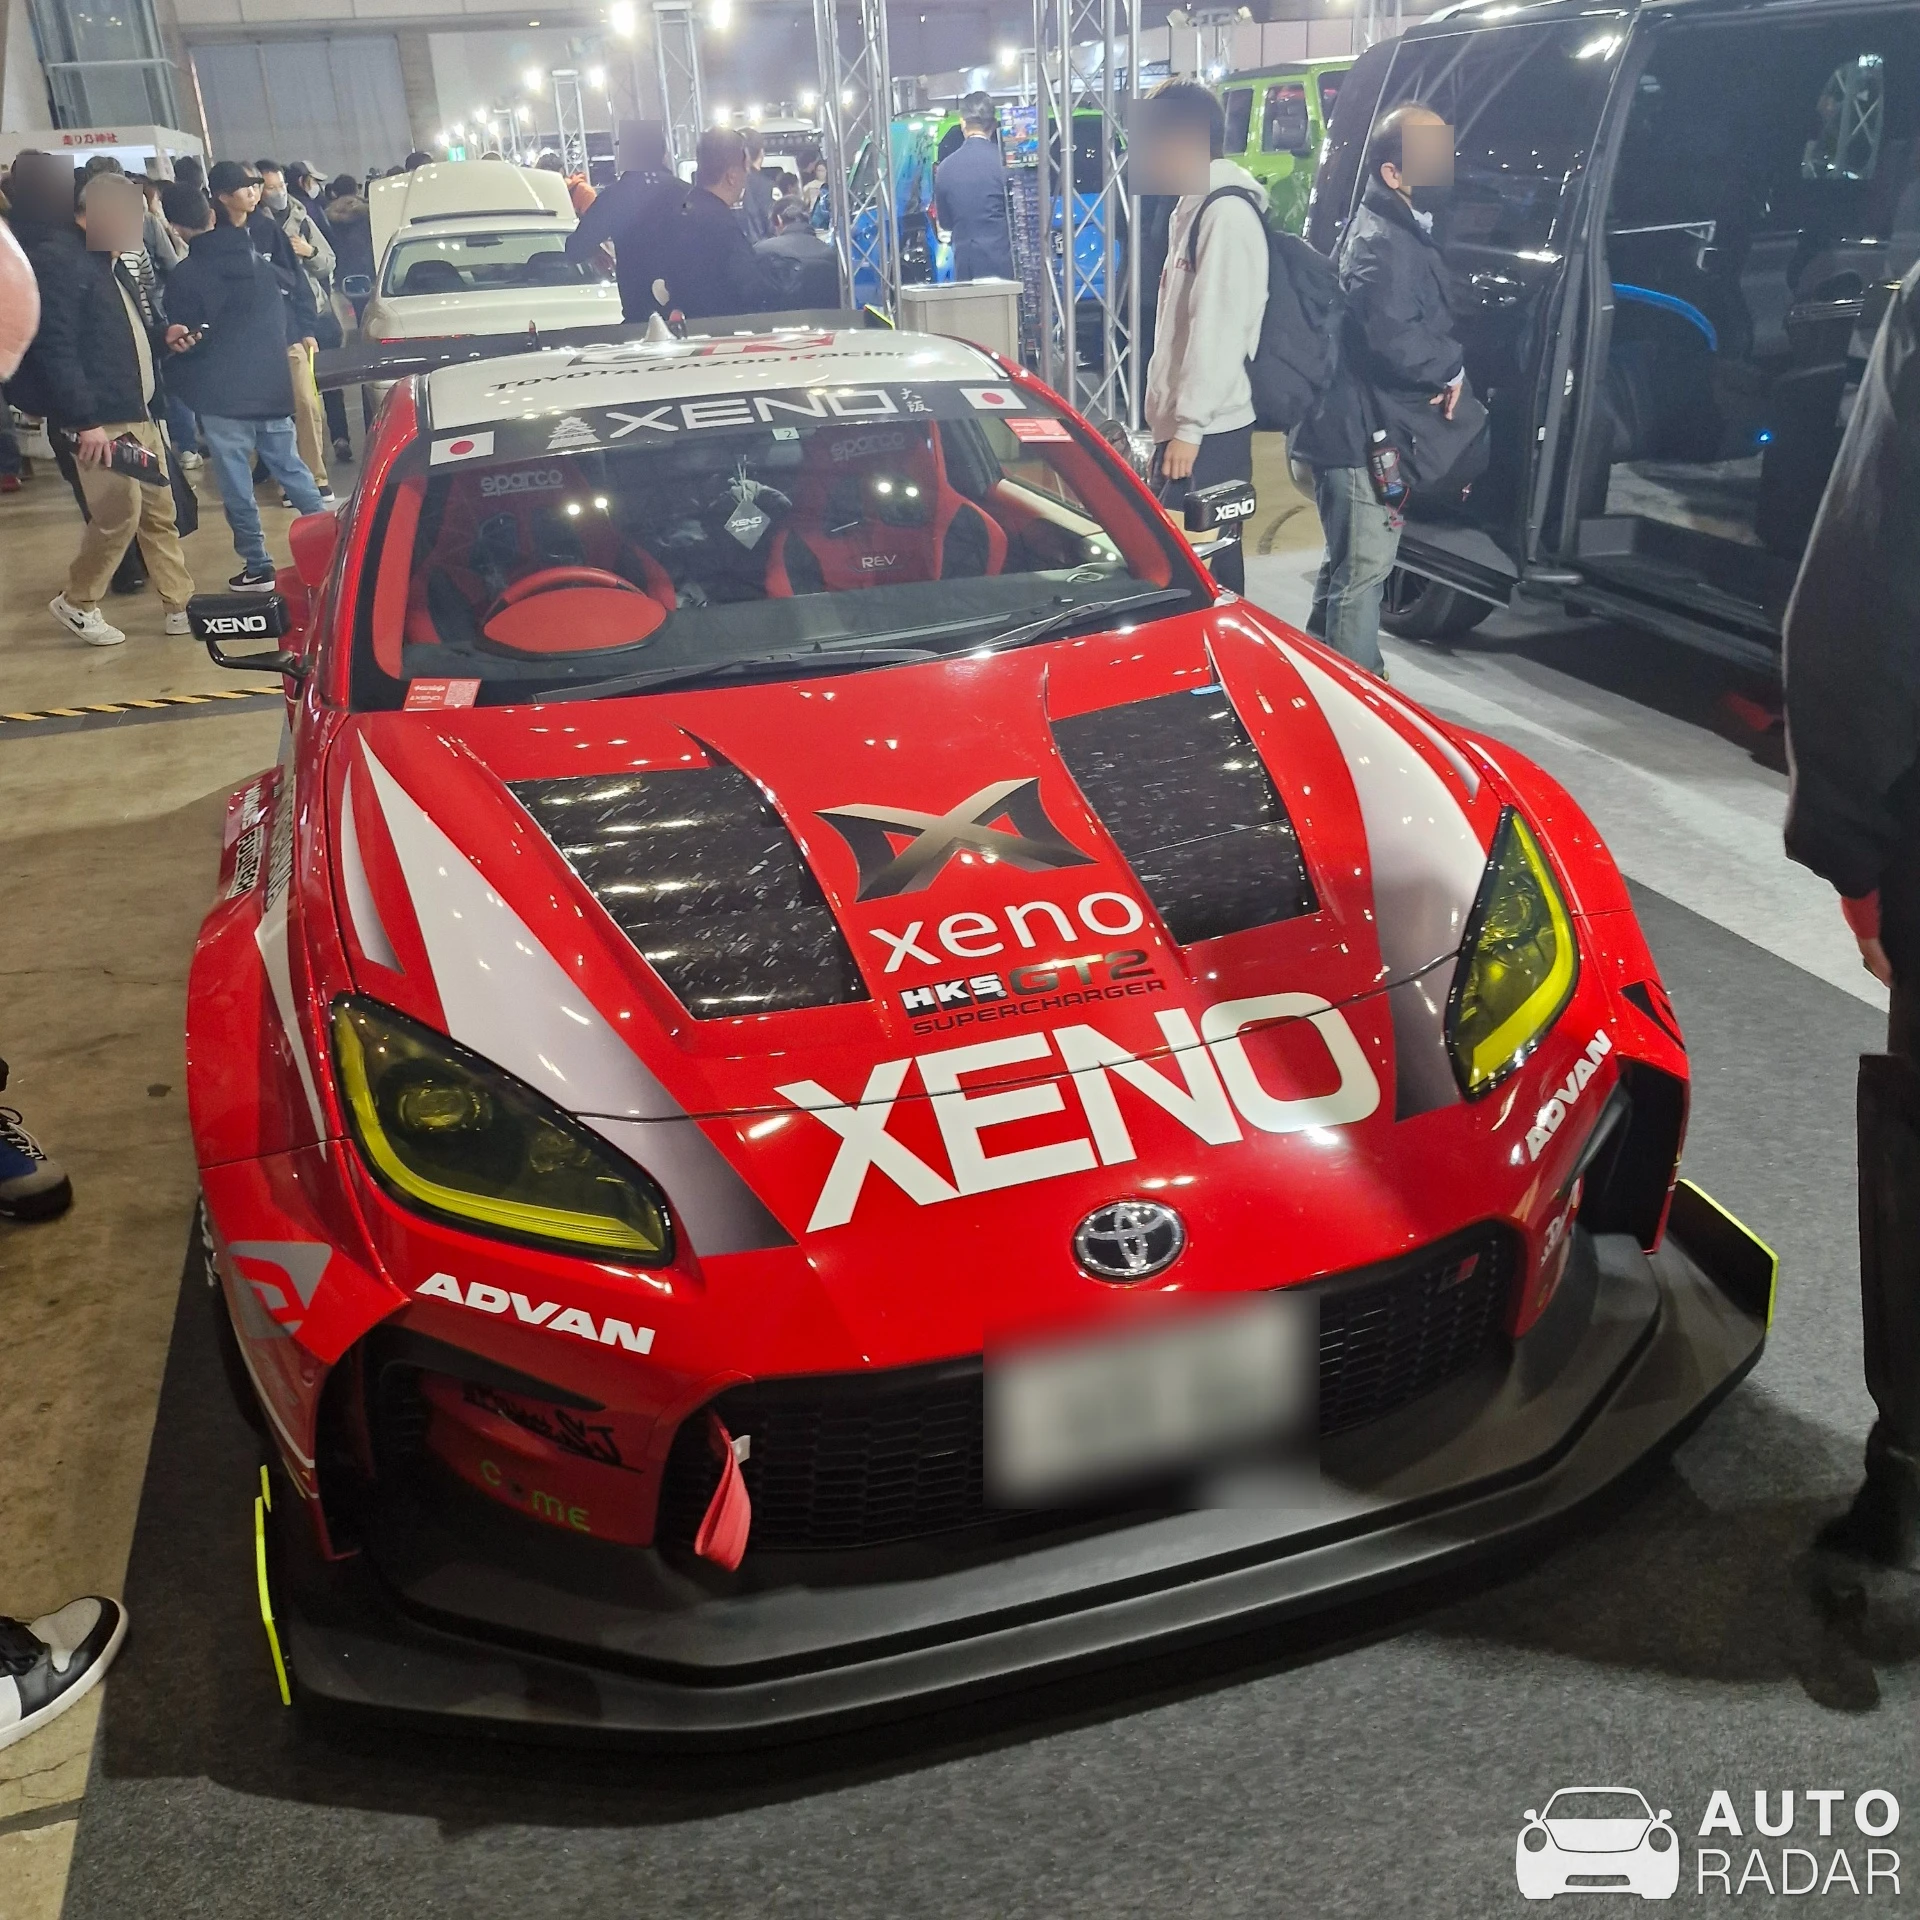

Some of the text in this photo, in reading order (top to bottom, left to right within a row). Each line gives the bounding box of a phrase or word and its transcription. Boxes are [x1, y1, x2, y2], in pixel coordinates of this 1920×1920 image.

[489, 369, 640, 390] TOYOTA
[646, 357, 781, 373] GAZOO
[605, 389, 899, 438] XENO
[481, 469, 563, 497] sparco
[731, 516, 762, 528] XENO
[1214, 499, 1255, 522] XENO
[862, 555, 896, 569] REV
[202, 615, 267, 634] XENO
[869, 892, 1144, 973] xeno
[900, 949, 1155, 1011] HKS GT2
[912, 980, 1167, 1036] SUPERCHARGER
[773, 992, 1382, 1233] XENO
[1524, 1028, 1613, 1163] ADVAN
[415, 1272, 656, 1355] ADVAN
